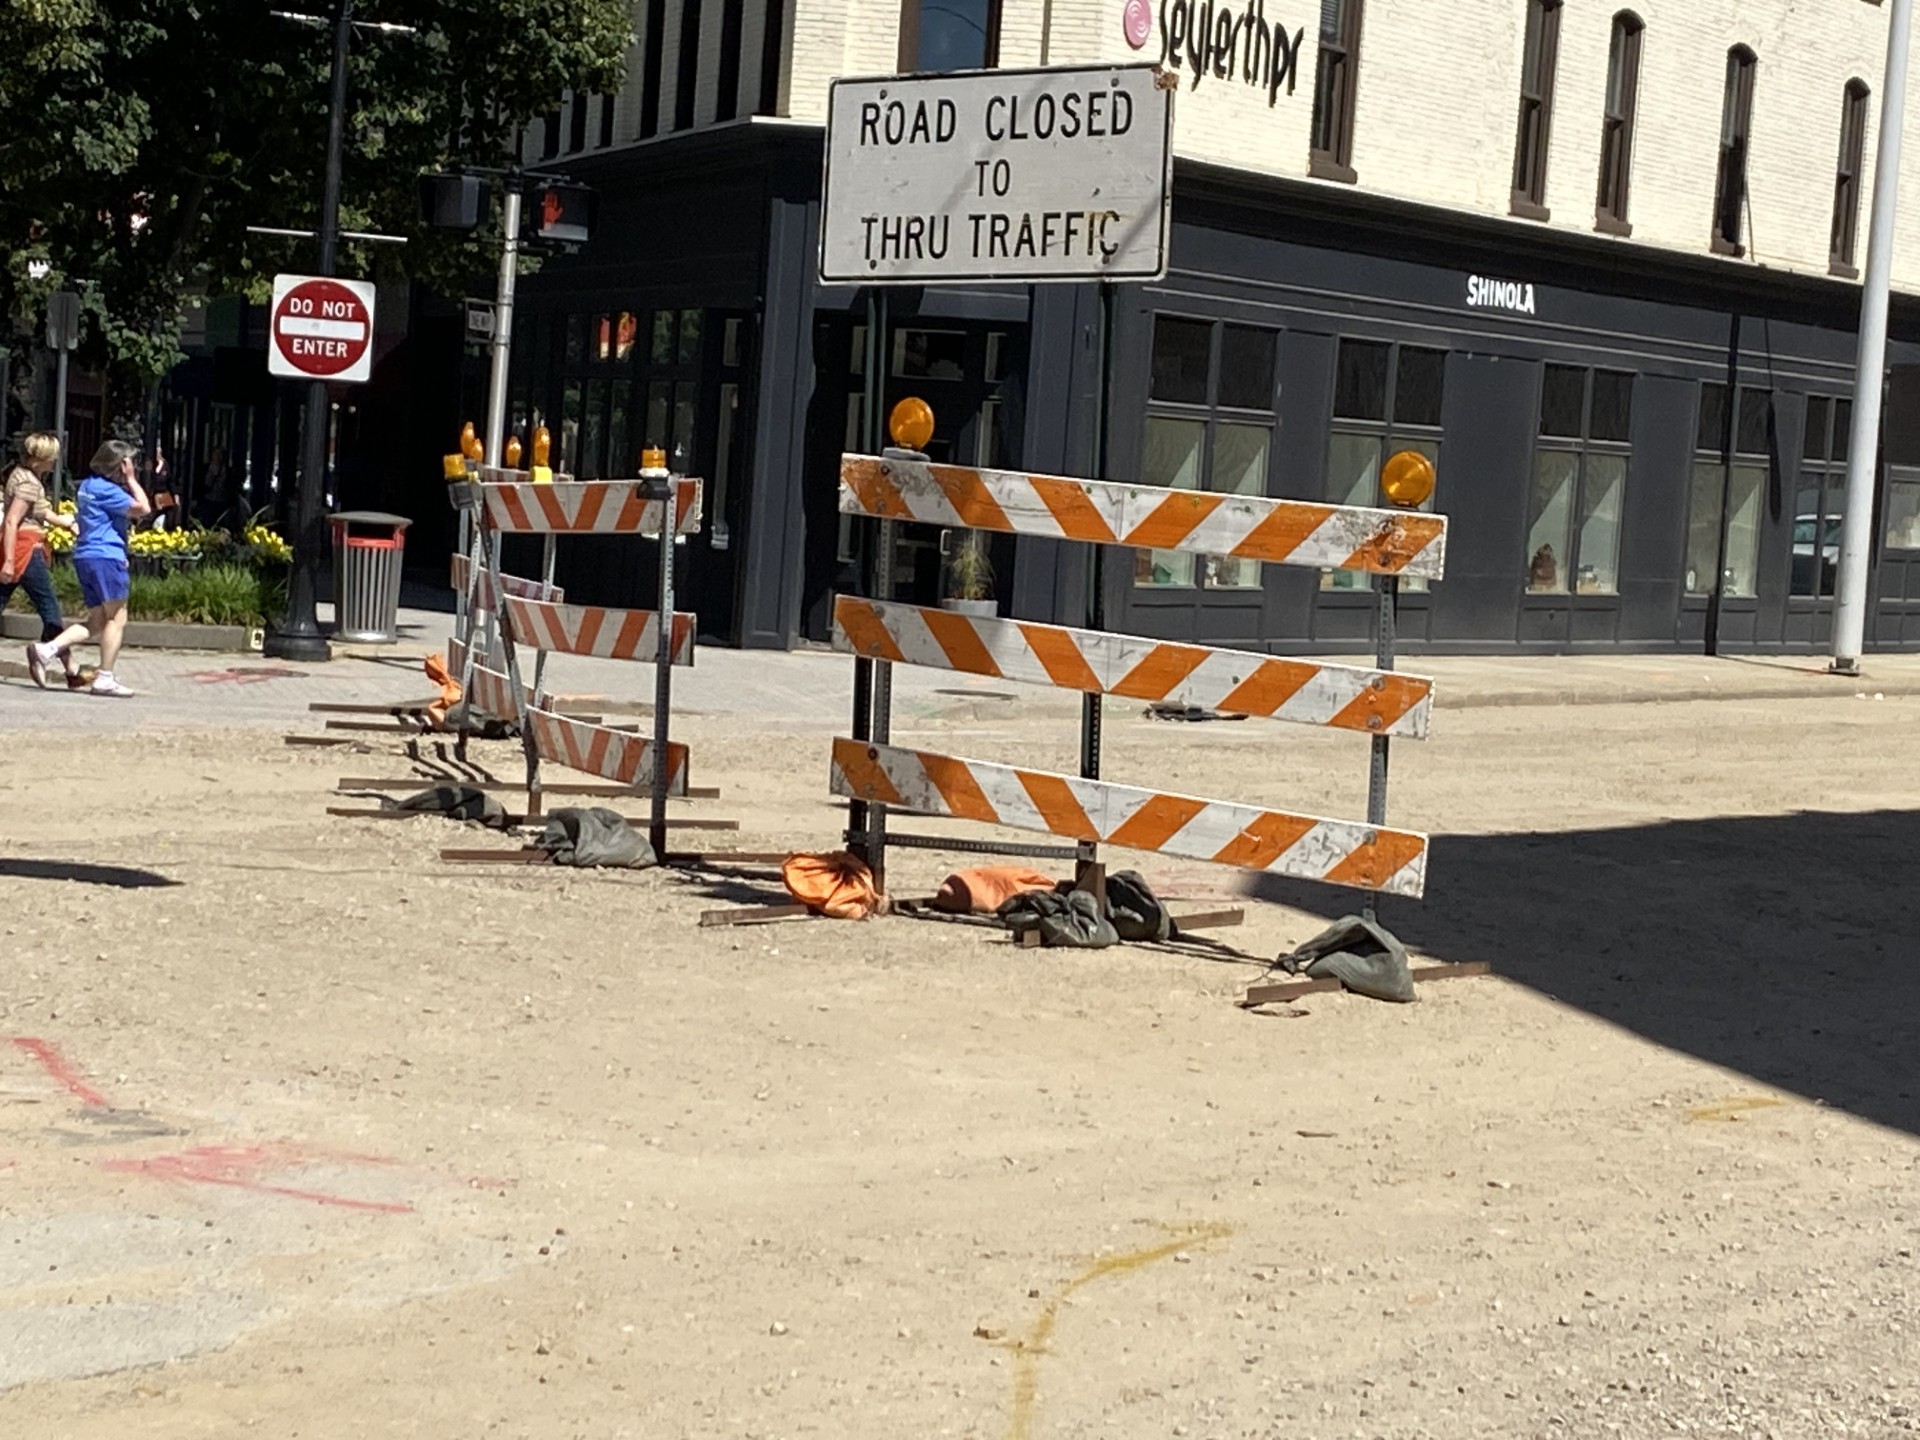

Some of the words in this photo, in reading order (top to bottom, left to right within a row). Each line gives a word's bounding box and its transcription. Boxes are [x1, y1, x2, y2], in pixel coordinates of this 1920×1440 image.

[860, 98, 957, 146] ROAD
[985, 90, 1133, 142] CLOSED
[974, 159, 1011, 197] TO
[861, 215, 949, 260] THRU
[968, 210, 1121, 258] TRAFFIC
[290, 297, 313, 315] DO
[322, 300, 356, 318] NOT
[1466, 274, 1535, 315] SHINOLA
[292, 338, 348, 358] ENTER
